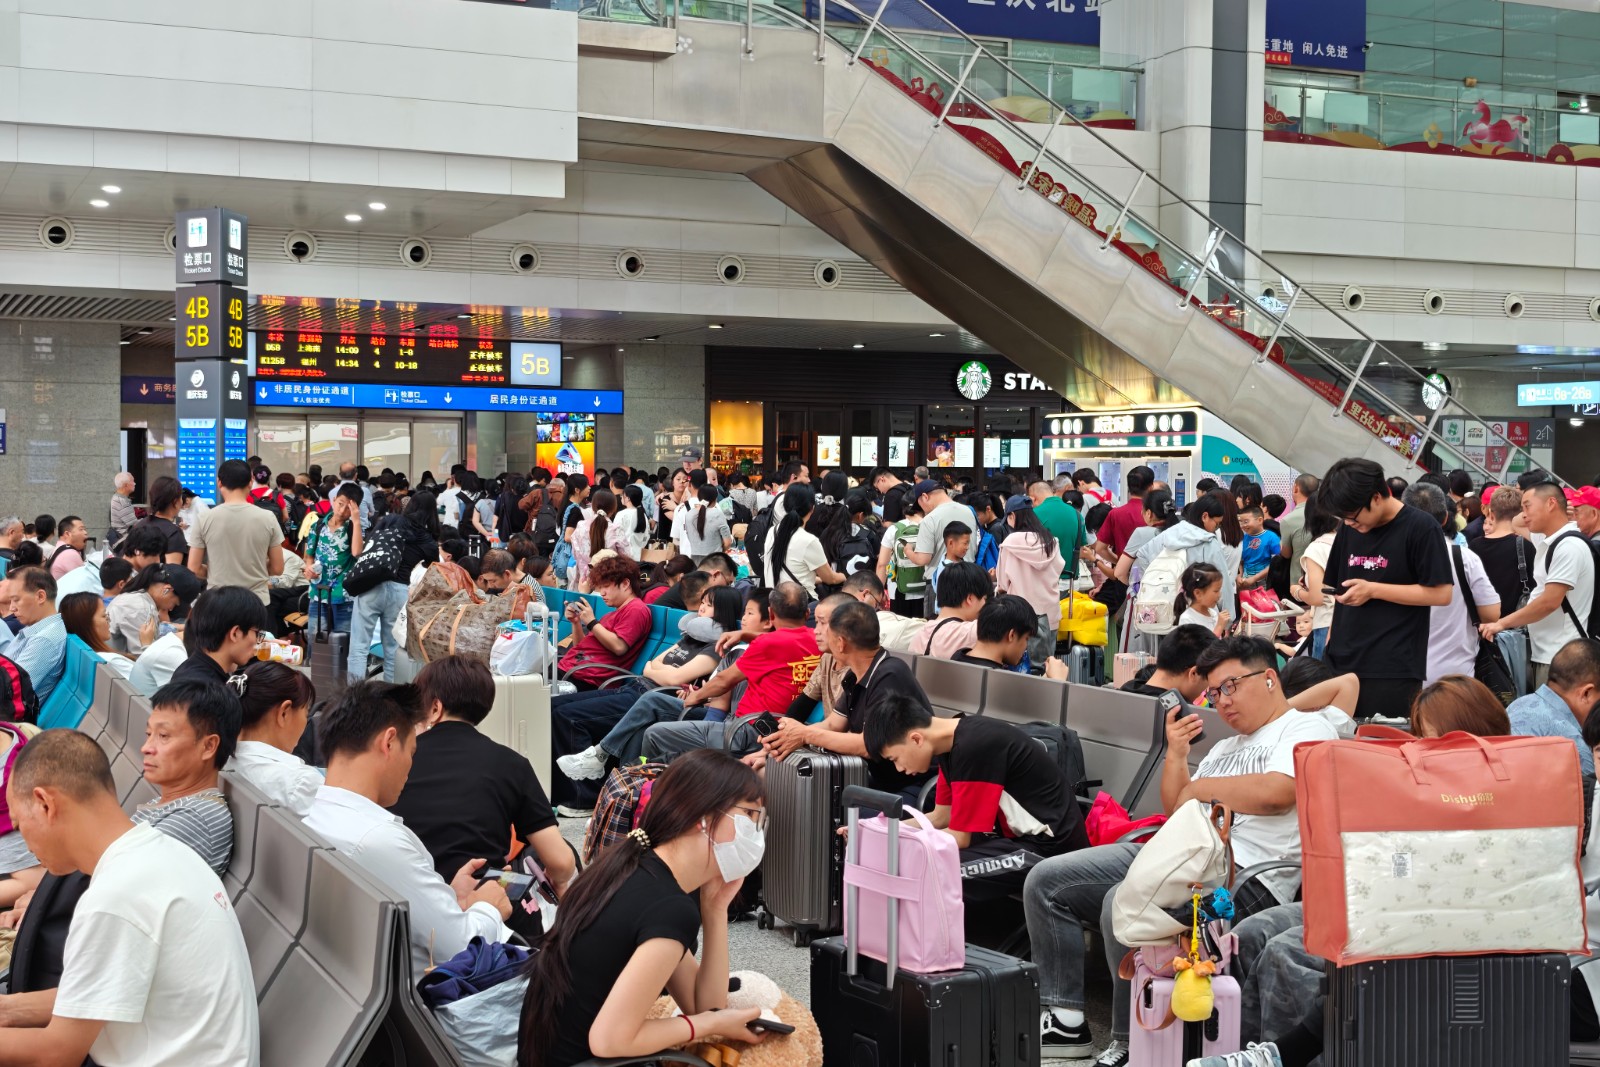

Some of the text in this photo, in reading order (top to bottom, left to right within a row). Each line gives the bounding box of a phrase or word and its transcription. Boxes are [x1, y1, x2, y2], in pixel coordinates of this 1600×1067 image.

[1302, 42, 1348, 58] 闲人免进
[184, 252, 212, 267] 检票口
[227, 252, 244, 269] 检票口
[185, 296, 209, 319] 4B
[229, 298, 243, 321] 4B
[186, 324, 210, 347] 5B
[229, 326, 243, 348] 5B
[374, 348, 380, 356] 4
[335, 359, 359, 368] 14:34
[374, 361, 380, 369] 4
[521, 353, 550, 375] 5B
[1004, 372, 1054, 391] STA
[274, 384, 350, 396] 非居民身份证通道
[401, 391, 421, 399] 检票口
[489, 394, 558, 406] 居民身份证通道
[1441, 793, 1477, 804] Dishu
